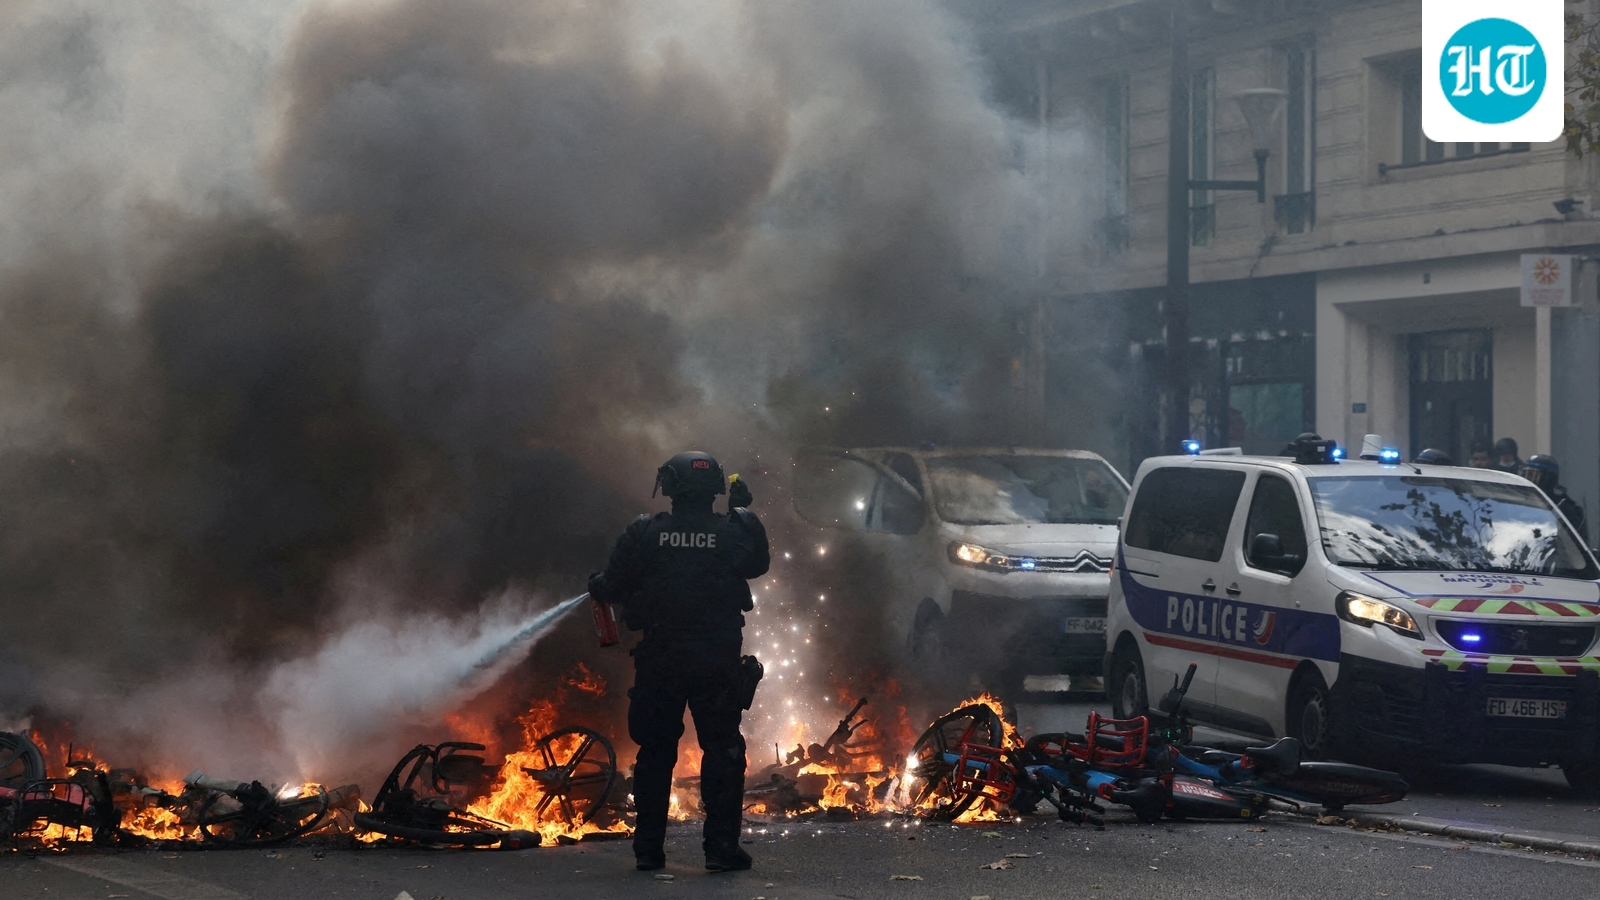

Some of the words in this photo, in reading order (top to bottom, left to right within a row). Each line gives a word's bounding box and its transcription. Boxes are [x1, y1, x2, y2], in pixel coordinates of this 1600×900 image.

[659, 532, 717, 548] POLICE
[1442, 577, 1544, 587] NATIONALE
[1167, 596, 1248, 641] POLICE
[1489, 700, 1558, 717] FD-466-HS
